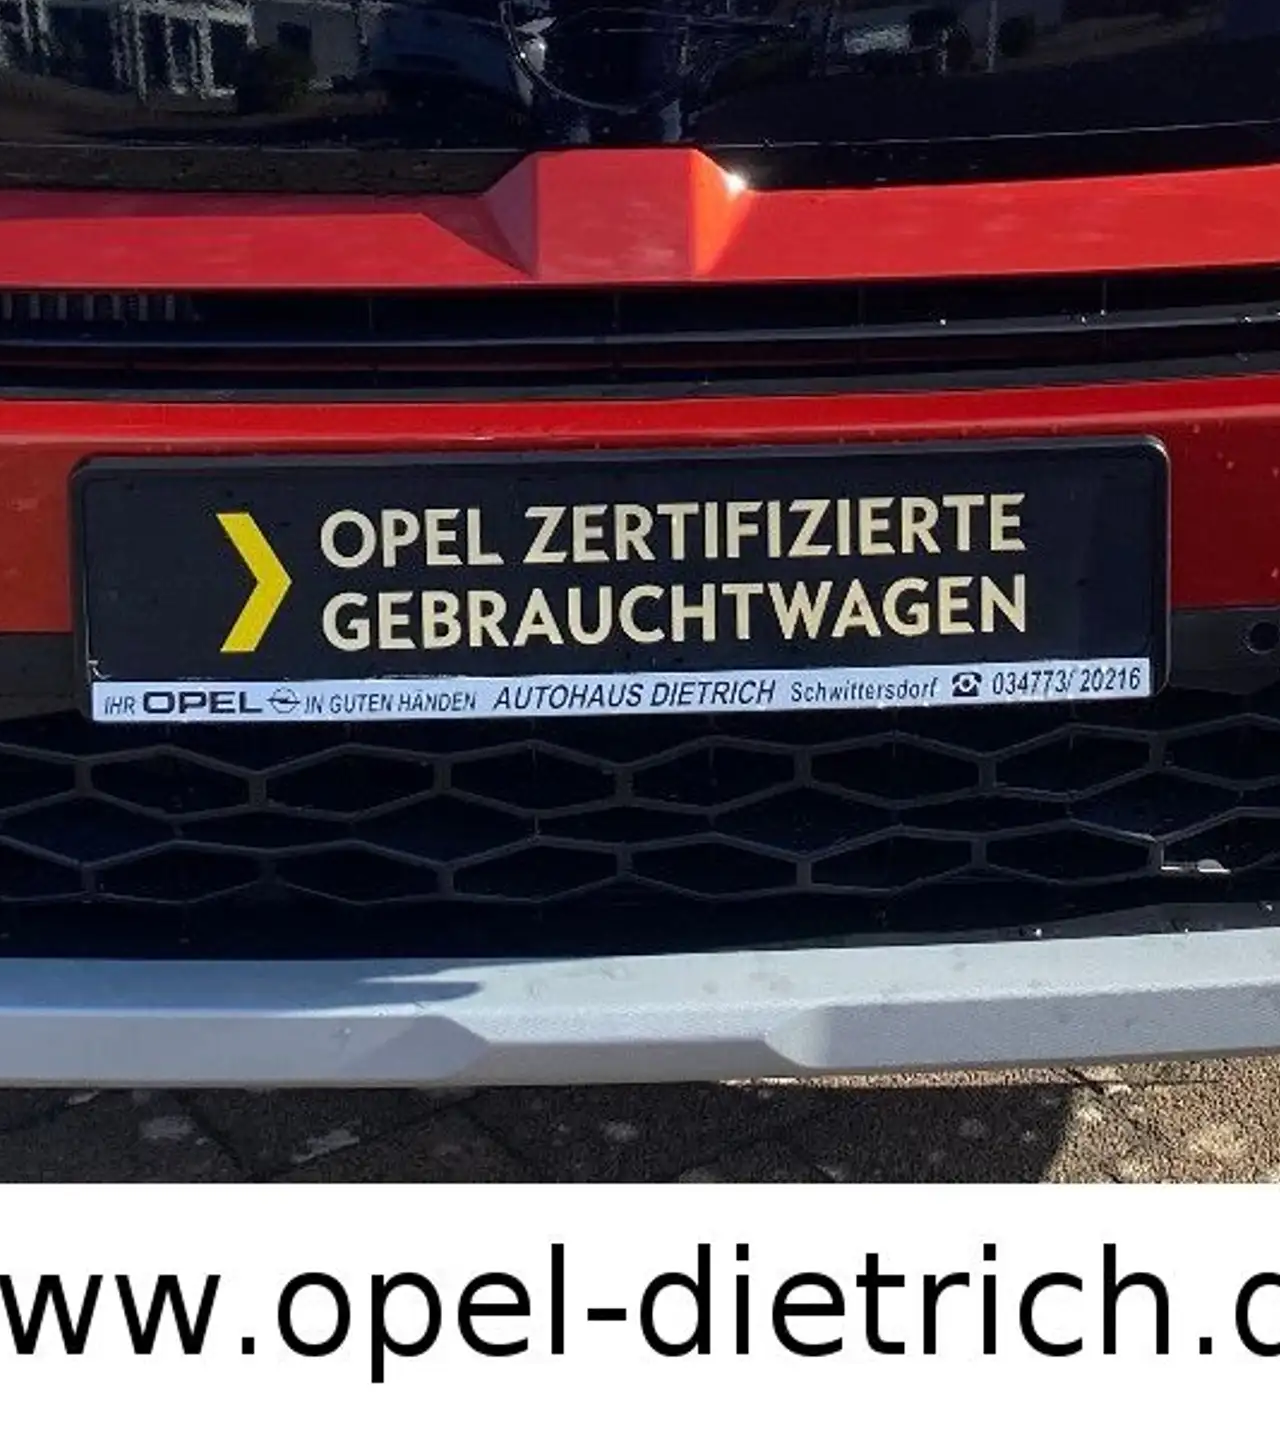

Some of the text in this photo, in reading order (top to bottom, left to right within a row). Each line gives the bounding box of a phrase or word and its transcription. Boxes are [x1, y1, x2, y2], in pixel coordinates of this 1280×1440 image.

[319, 493, 1027, 568] OPEL ZERTIFIZIERTE
[321, 574, 1027, 651] GEBRAUCHTWAGEN
[104, 695, 136, 715] IHR
[142, 691, 263, 714] OPEL
[303, 696, 322, 715] IN
[329, 693, 395, 714] GUTEN
[397, 688, 477, 712] HÄNDEN
[493, 682, 645, 710] AUTOHAUS
[650, 679, 777, 707] DIETRICH
[790, 676, 940, 703] Schwittersdorf
[1078, 666, 1142, 693] 20216
